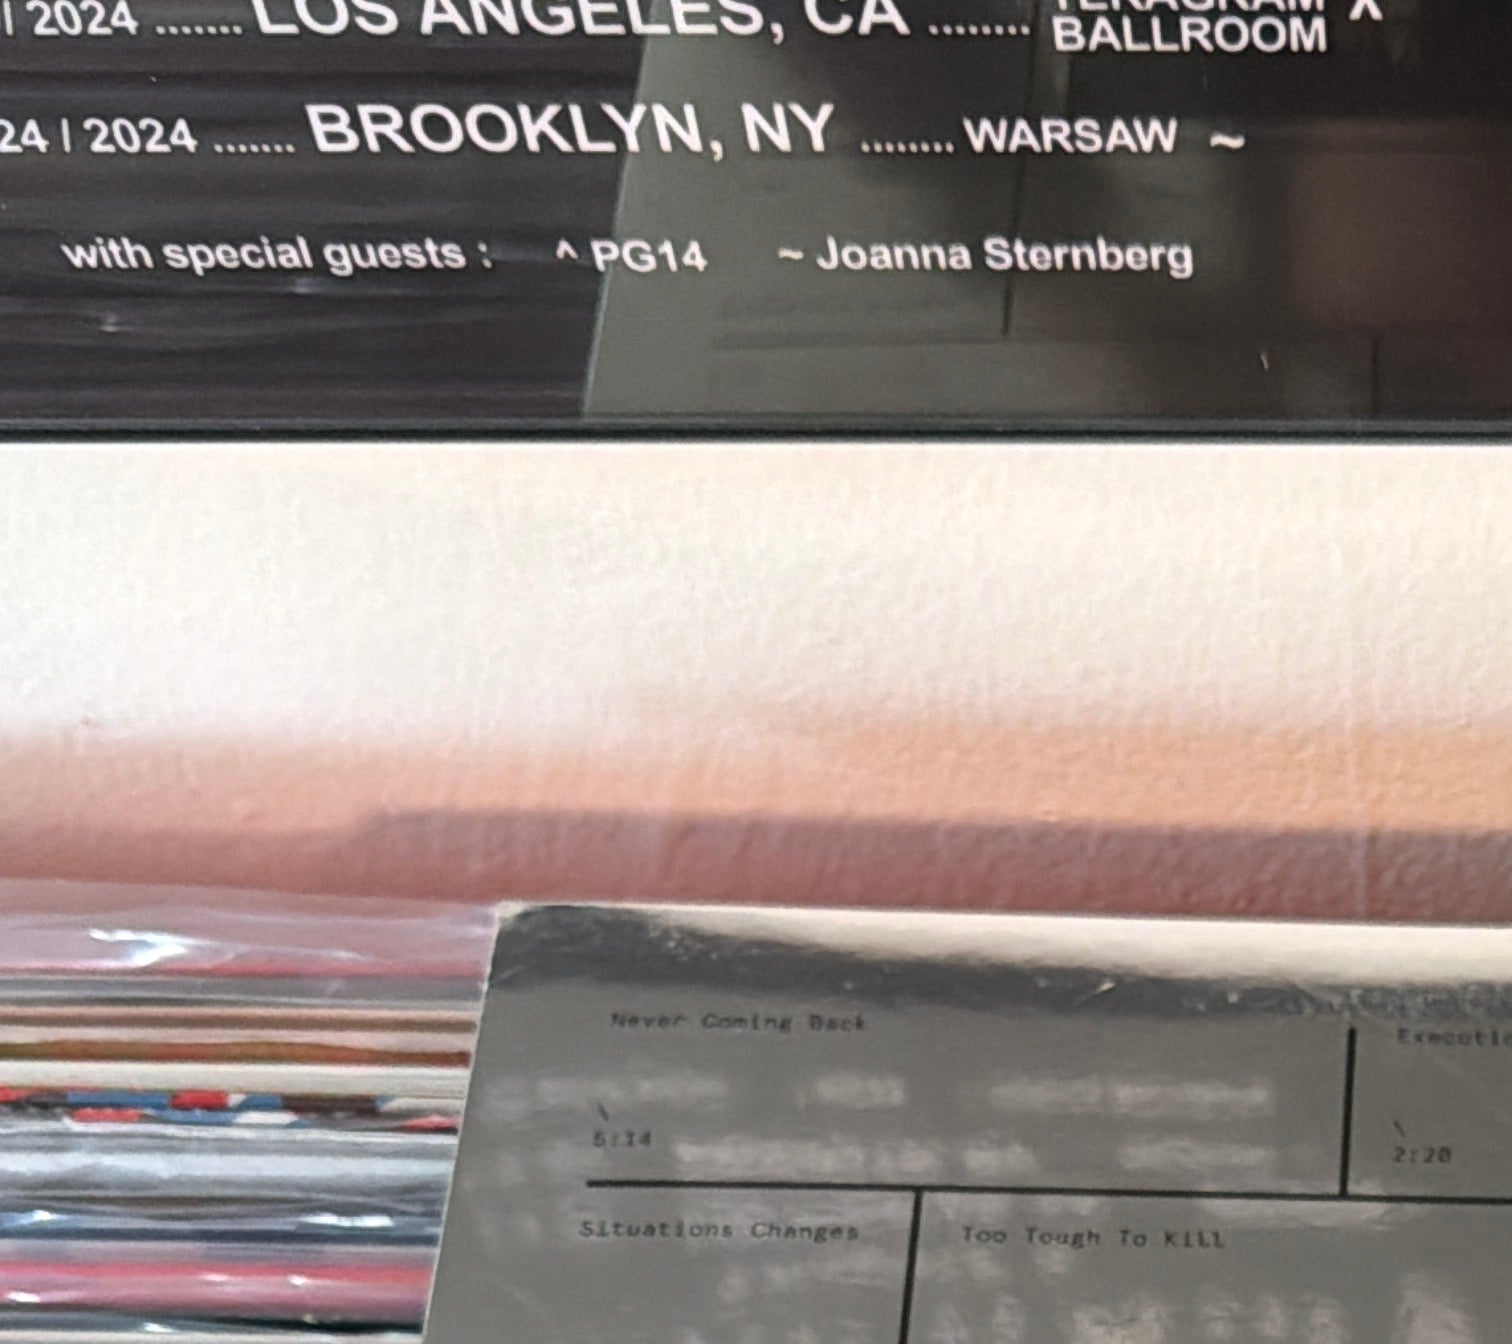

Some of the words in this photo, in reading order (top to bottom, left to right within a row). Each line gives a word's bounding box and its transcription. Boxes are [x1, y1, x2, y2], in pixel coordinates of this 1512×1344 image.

[27, 0, 138, 35] 2024
[255, 0, 398, 35] LOS
[420, 0, 784, 44] ANGELES,
[807, 0, 909, 35] CA
[1053, 16, 1327, 52] BALLROOM
[83, 118, 197, 153] 2024
[305, 104, 723, 161] BROOKLYN,
[743, 104, 834, 152] NY
[963, 118, 1178, 154] WARSAW
[62, 237, 154, 270] with
[164, 237, 310, 275] special
[592, 240, 706, 272] PG14
[816, 238, 971, 271] Joanna
[983, 238, 1193, 278] Sternberg
[611, 1012, 687, 1031] Never
[702, 1013, 792, 1033] Coming
[808, 1012, 866, 1032] Back
[579, 1219, 734, 1239] Situations
[751, 1221, 860, 1243] Changes
[963, 1226, 1008, 1245] Too
[1025, 1227, 1100, 1248] Tough
[1120, 1228, 1147, 1247] To
[1164, 1230, 1226, 1248] Kill
